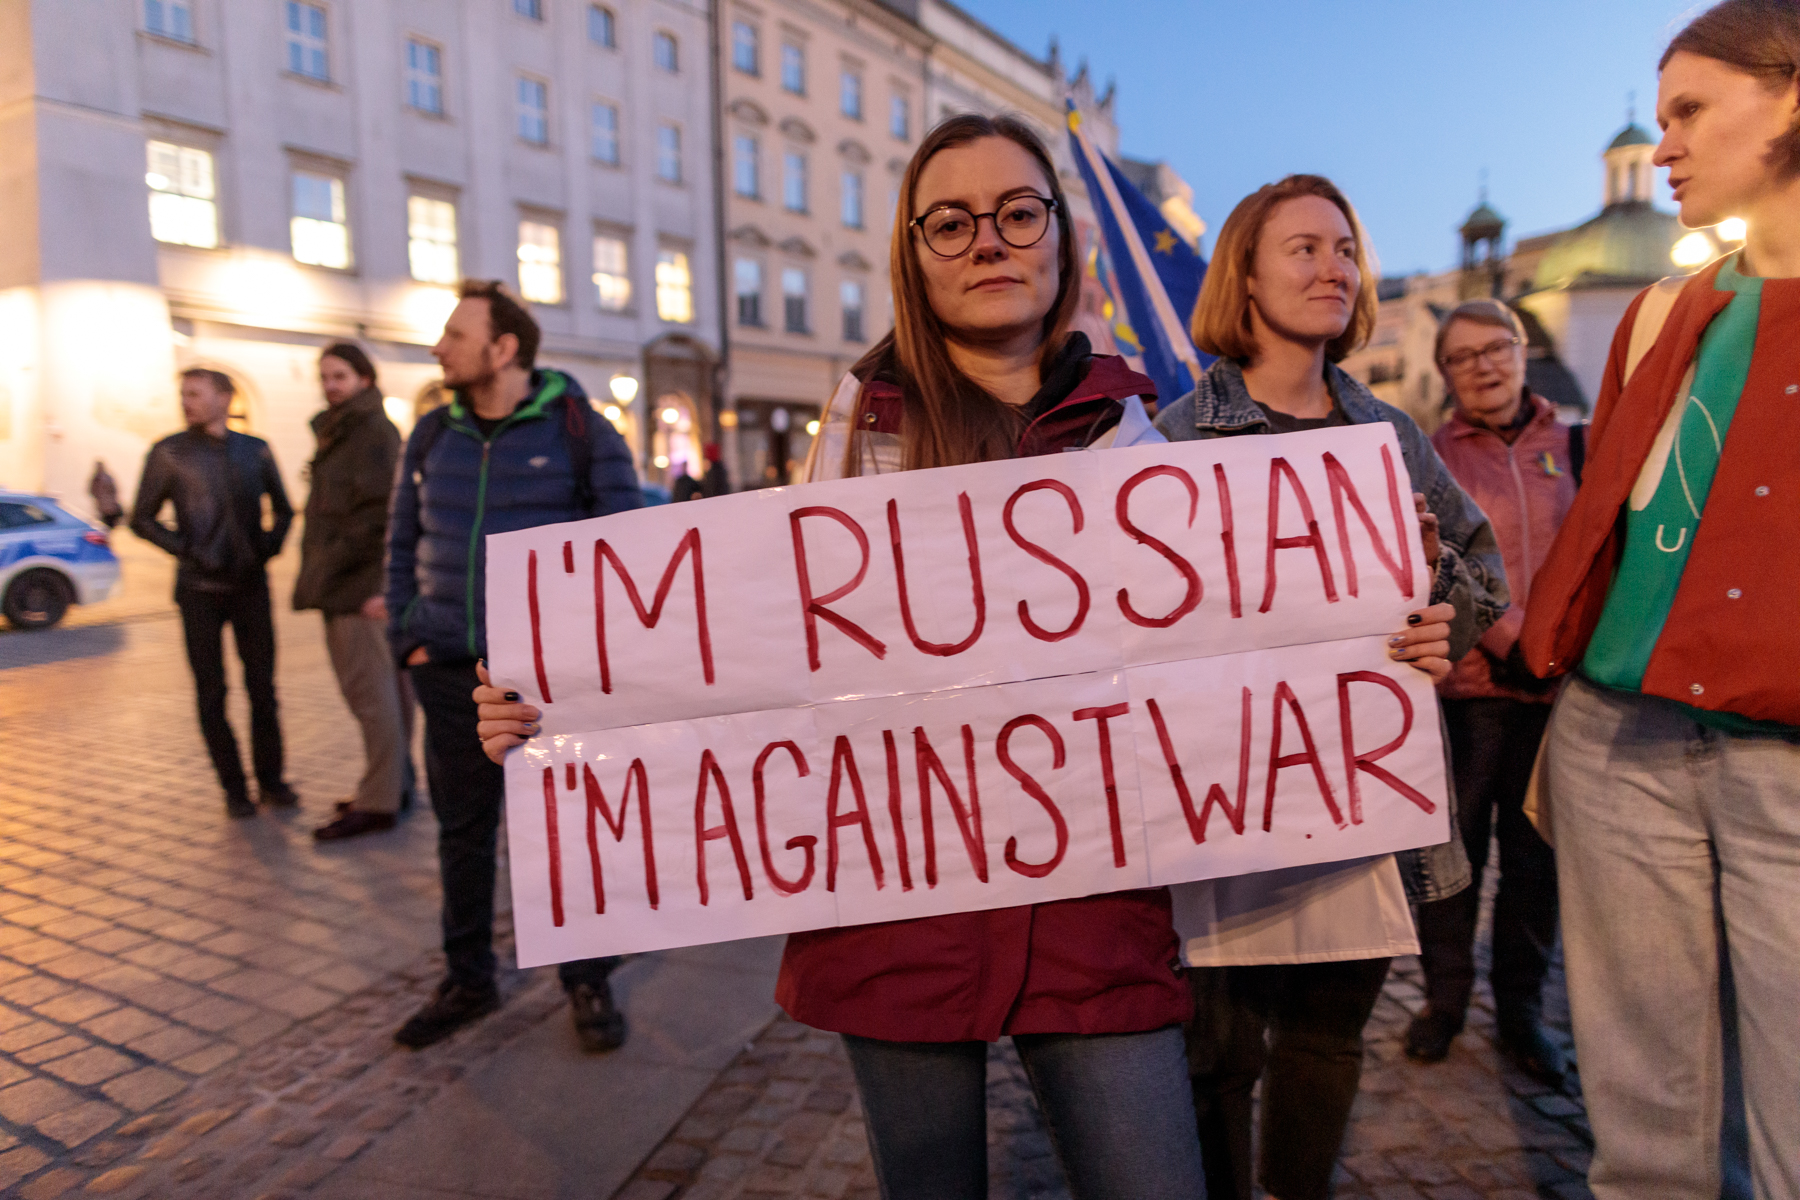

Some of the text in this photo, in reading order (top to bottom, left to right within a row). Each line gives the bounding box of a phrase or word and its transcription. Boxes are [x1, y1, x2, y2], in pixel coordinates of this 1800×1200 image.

[528, 443, 1414, 703] I'M RUSSIAN
[543, 670, 1436, 927] I'M AGAINST WAR
